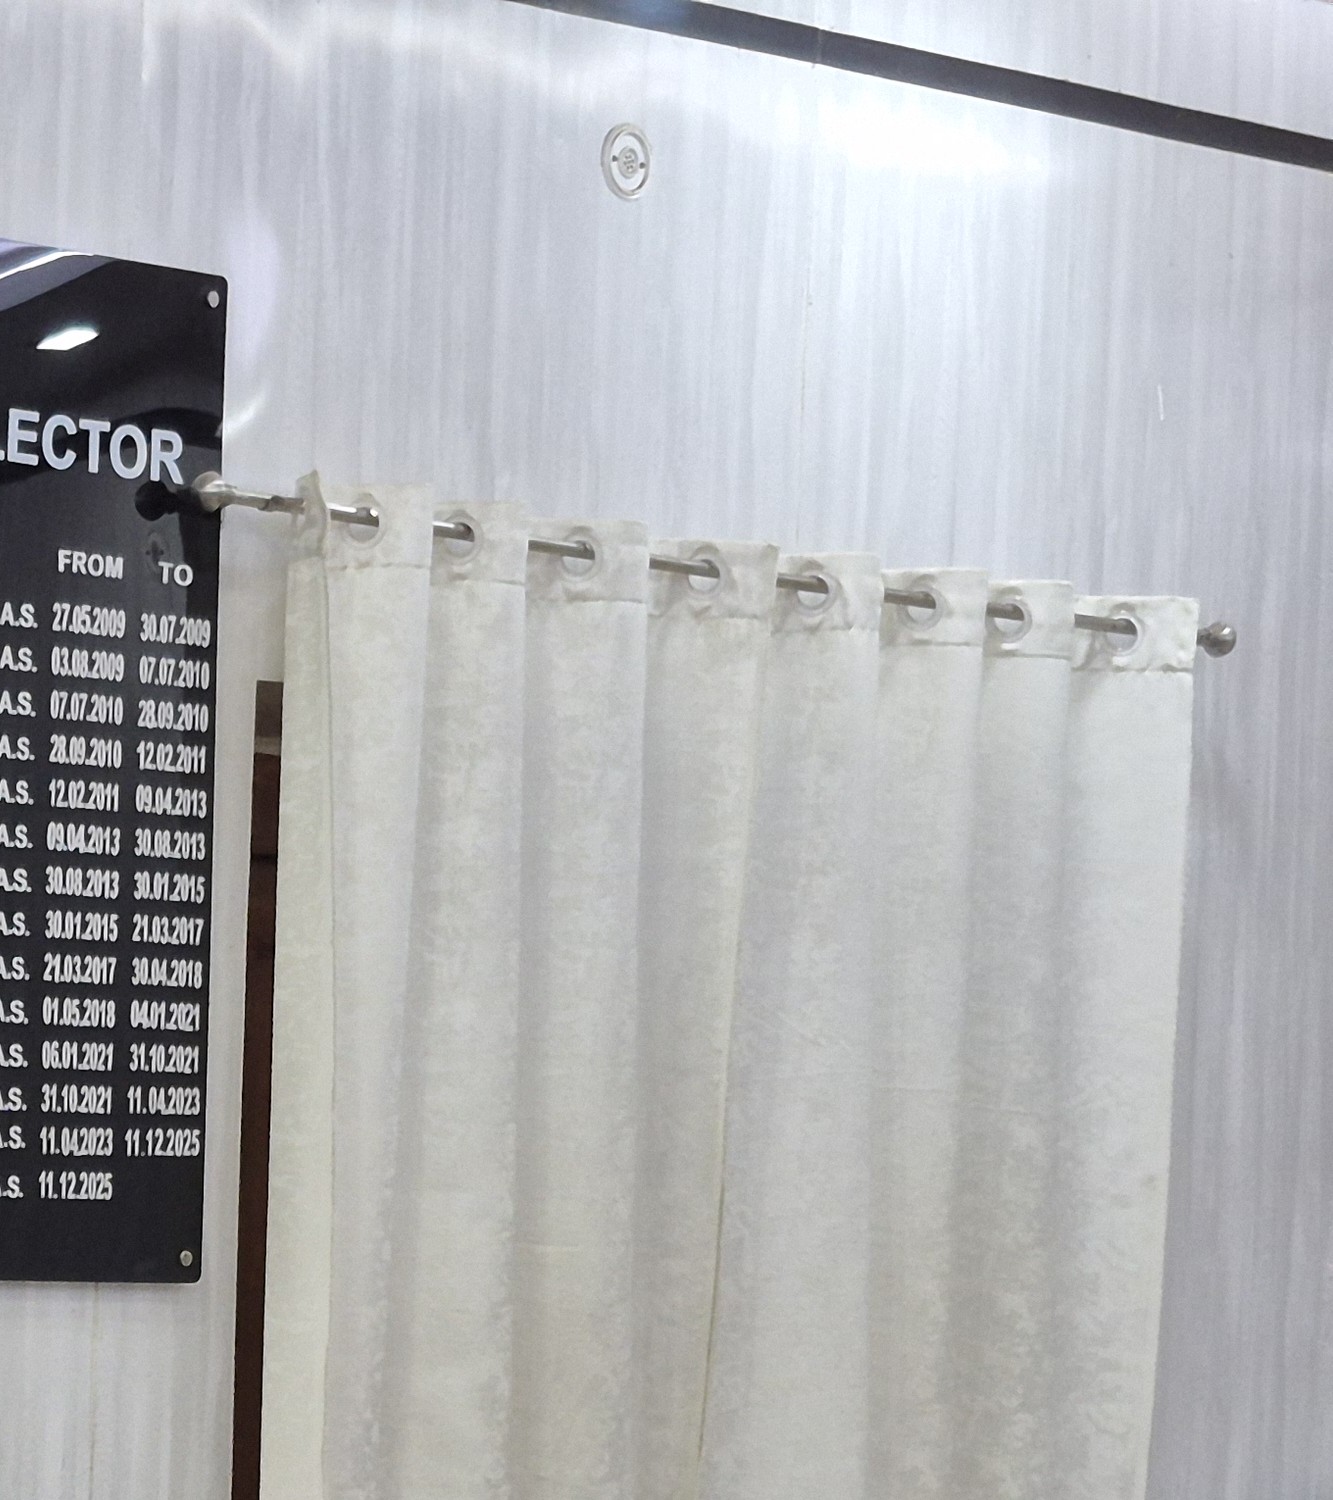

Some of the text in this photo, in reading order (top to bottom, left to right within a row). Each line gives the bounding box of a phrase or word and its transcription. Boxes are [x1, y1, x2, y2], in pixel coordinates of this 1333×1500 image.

[57, 548, 125, 581] FROM
[157, 560, 195, 588] TO
[51, 601, 127, 640] 27.05.2009
[139, 612, 212, 650] 30.07.2009
[48, 733, 123, 770] 28.09.2010
[135, 739, 208, 775] 12.02.2011
[48, 778, 120, 814] 12.02.2011
[135, 783, 208, 820] 09.04.2013
[44, 864, 121, 901] 30.08.2013
[133, 870, 207, 905] 30.01.2015
[42, 951, 118, 986] 21.03.2017
[130, 956, 204, 991] 30.04.2018
[38, 1169, 114, 1202] 11.12.2025
